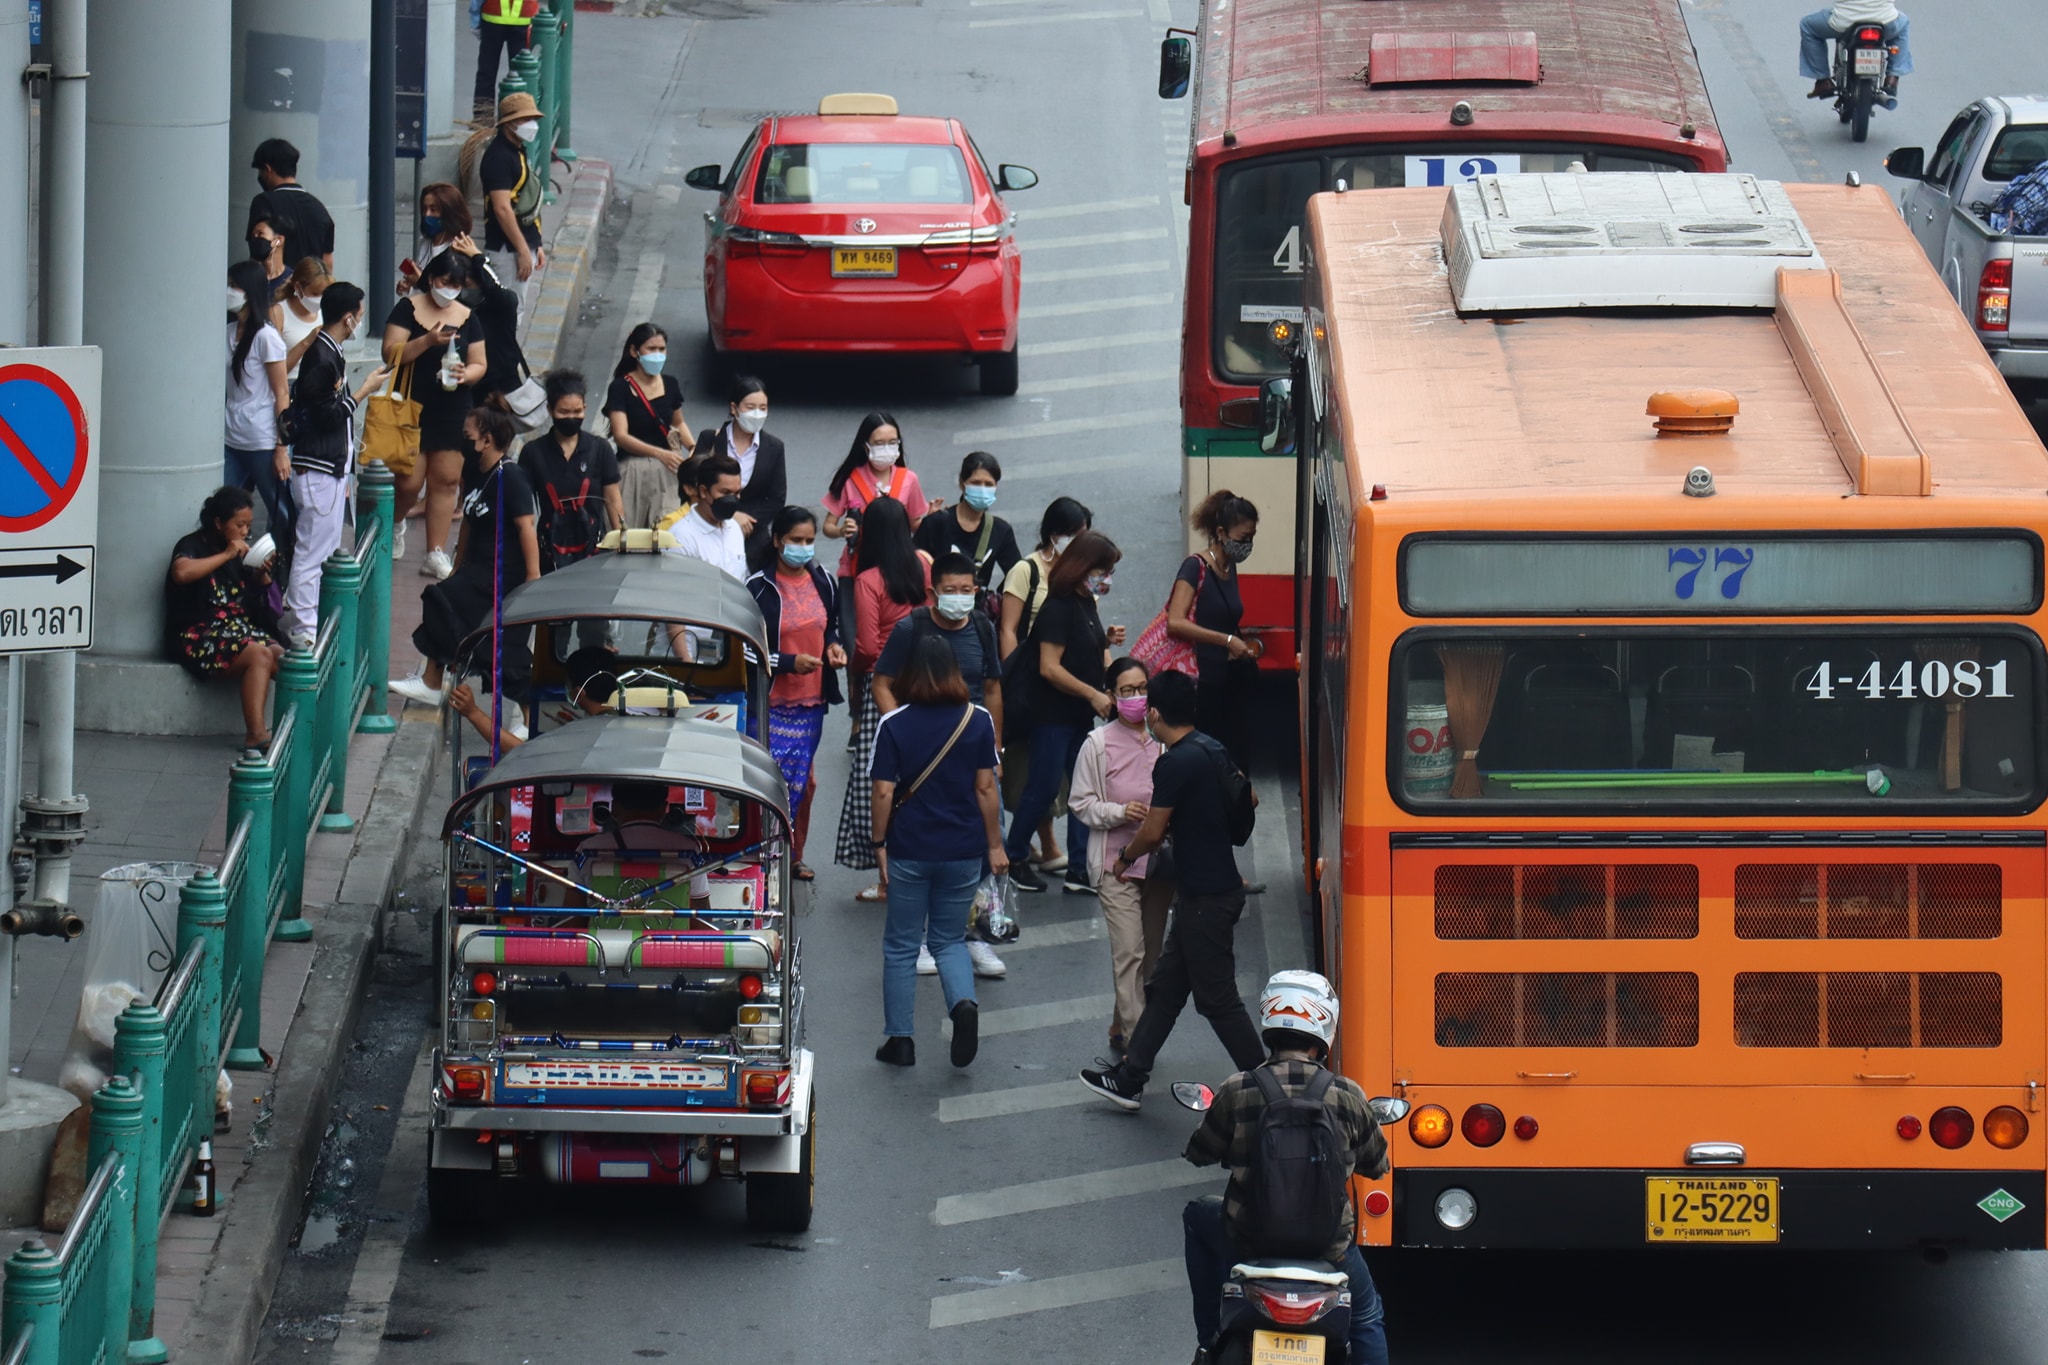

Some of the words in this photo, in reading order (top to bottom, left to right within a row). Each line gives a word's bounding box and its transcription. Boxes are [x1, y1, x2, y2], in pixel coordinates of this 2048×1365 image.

[864, 252, 893, 264] 9469
[1668, 547, 1753, 599] 77
[1806, 660, 2014, 699] 4-44081
[525, 1063, 706, 1088] THAILAND
[1677, 1181, 1747, 1191] THAILAND
[1756, 1182, 1768, 1190] 01
[1660, 1193, 1770, 1223] 12-5229
[1988, 1198, 2014, 1208] CNG
[1674, 1228, 1751, 1239] กรุงเทพมหานคร
